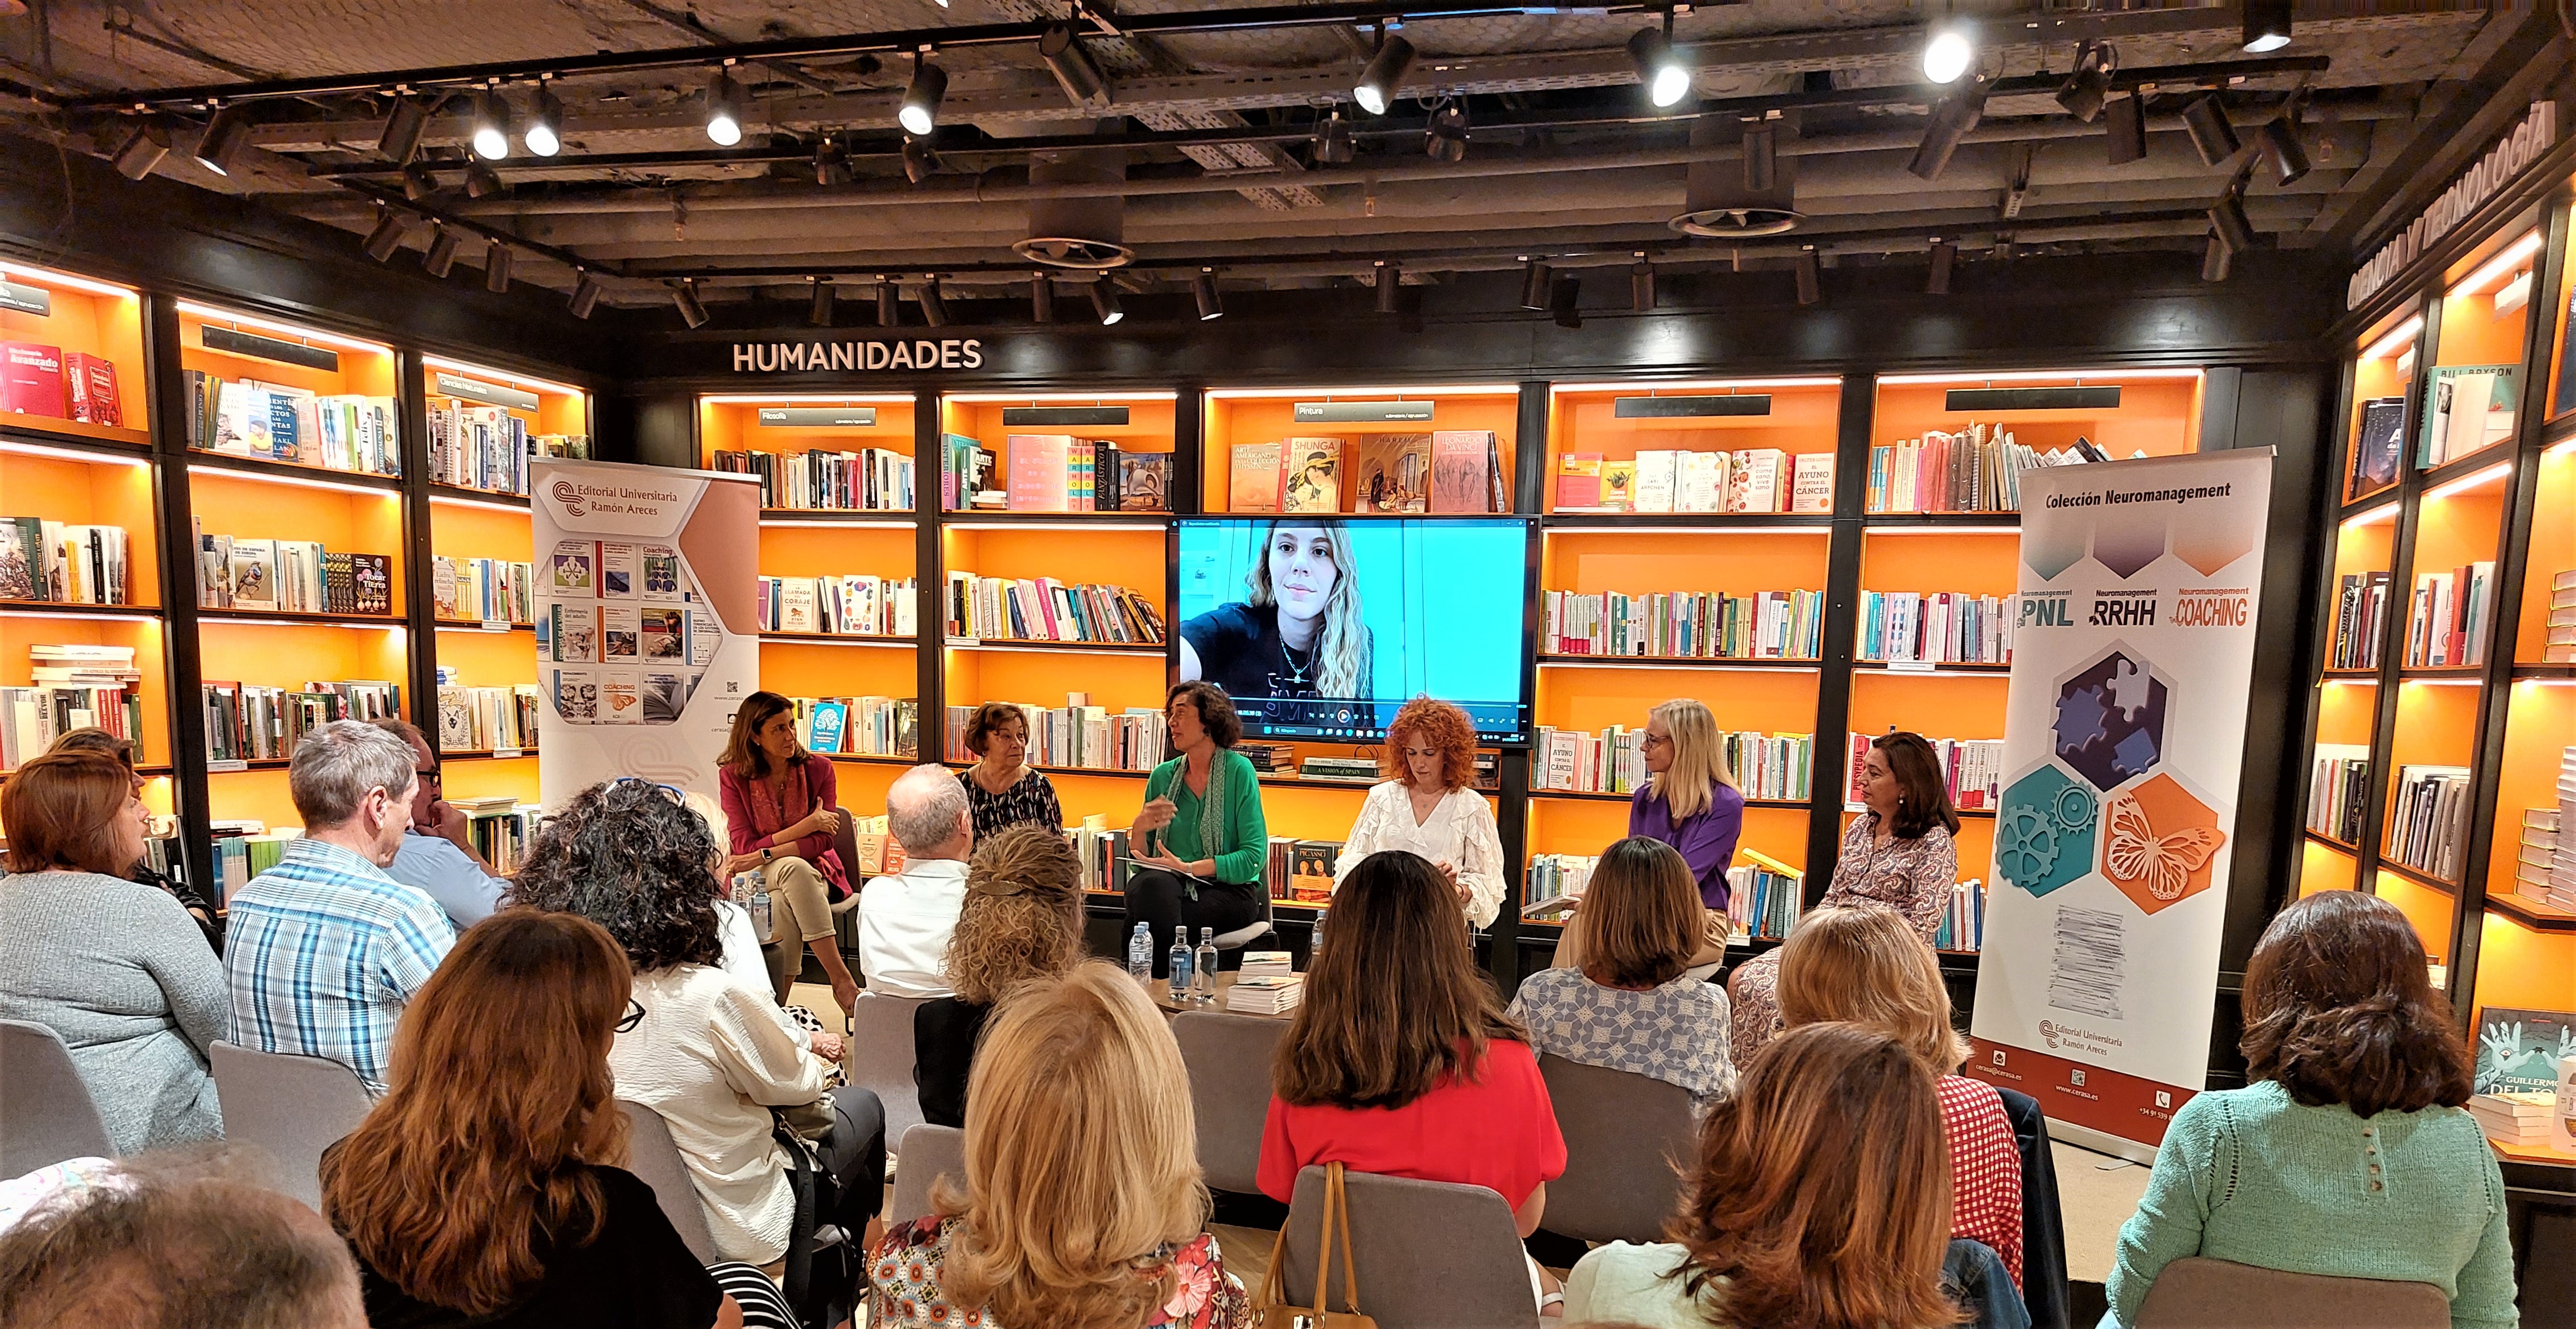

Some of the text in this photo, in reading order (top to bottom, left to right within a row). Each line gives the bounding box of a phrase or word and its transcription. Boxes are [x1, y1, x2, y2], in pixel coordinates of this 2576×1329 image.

[2407, 217, 2425, 263] Y
[11, 354, 58, 368] Avanzado
[733, 340, 983, 372] HUMANIDADES
[69, 366, 80, 403] Secundaria
[440, 377, 488, 395] Ciencias Naturales
[1299, 407, 1323, 415] Pintura
[1294, 441, 1336, 451] SHUNGA
[1442, 436, 1482, 445] LEONARDO
[975, 454, 992, 464] ARTE
[1798, 471, 1829, 479] AYUNO
[578, 484, 678, 502] Editorial Universitaria
[1795, 485, 1829, 495] CÁNCER
[2046, 482, 2231, 508] Colección Neuromanagement
[591, 501, 658, 515] Ramón Areces
[643, 546, 673, 556] Coaching
[366, 573, 386, 582] Tocar
[363, 580, 386, 589] Tierra
[2021, 589, 2072, 597] Neuromanagement
[2096, 588, 2157, 597] Neuromanagement
[2179, 587, 2249, 597] Neuromanagement
[2022, 599, 2074, 626] PNL
[2093, 600, 2156, 626] RRHH
[2176, 598, 2247, 627] COACHING
[1551, 762, 1572, 772] CÁNCER
[1299, 849, 1326, 858] PICASSO
[2055, 1024, 2122, 1048] Editorial Universitaria
[2062, 1038, 2107, 1057] Ramón Areces
[1975, 1063, 2022, 1081] cerasa@cerasa.es
[2056, 1085, 2099, 1101] www.cerasa.es
[2139, 1107, 2149, 1116] +34
[2157, 1111, 2168, 1120] 539
